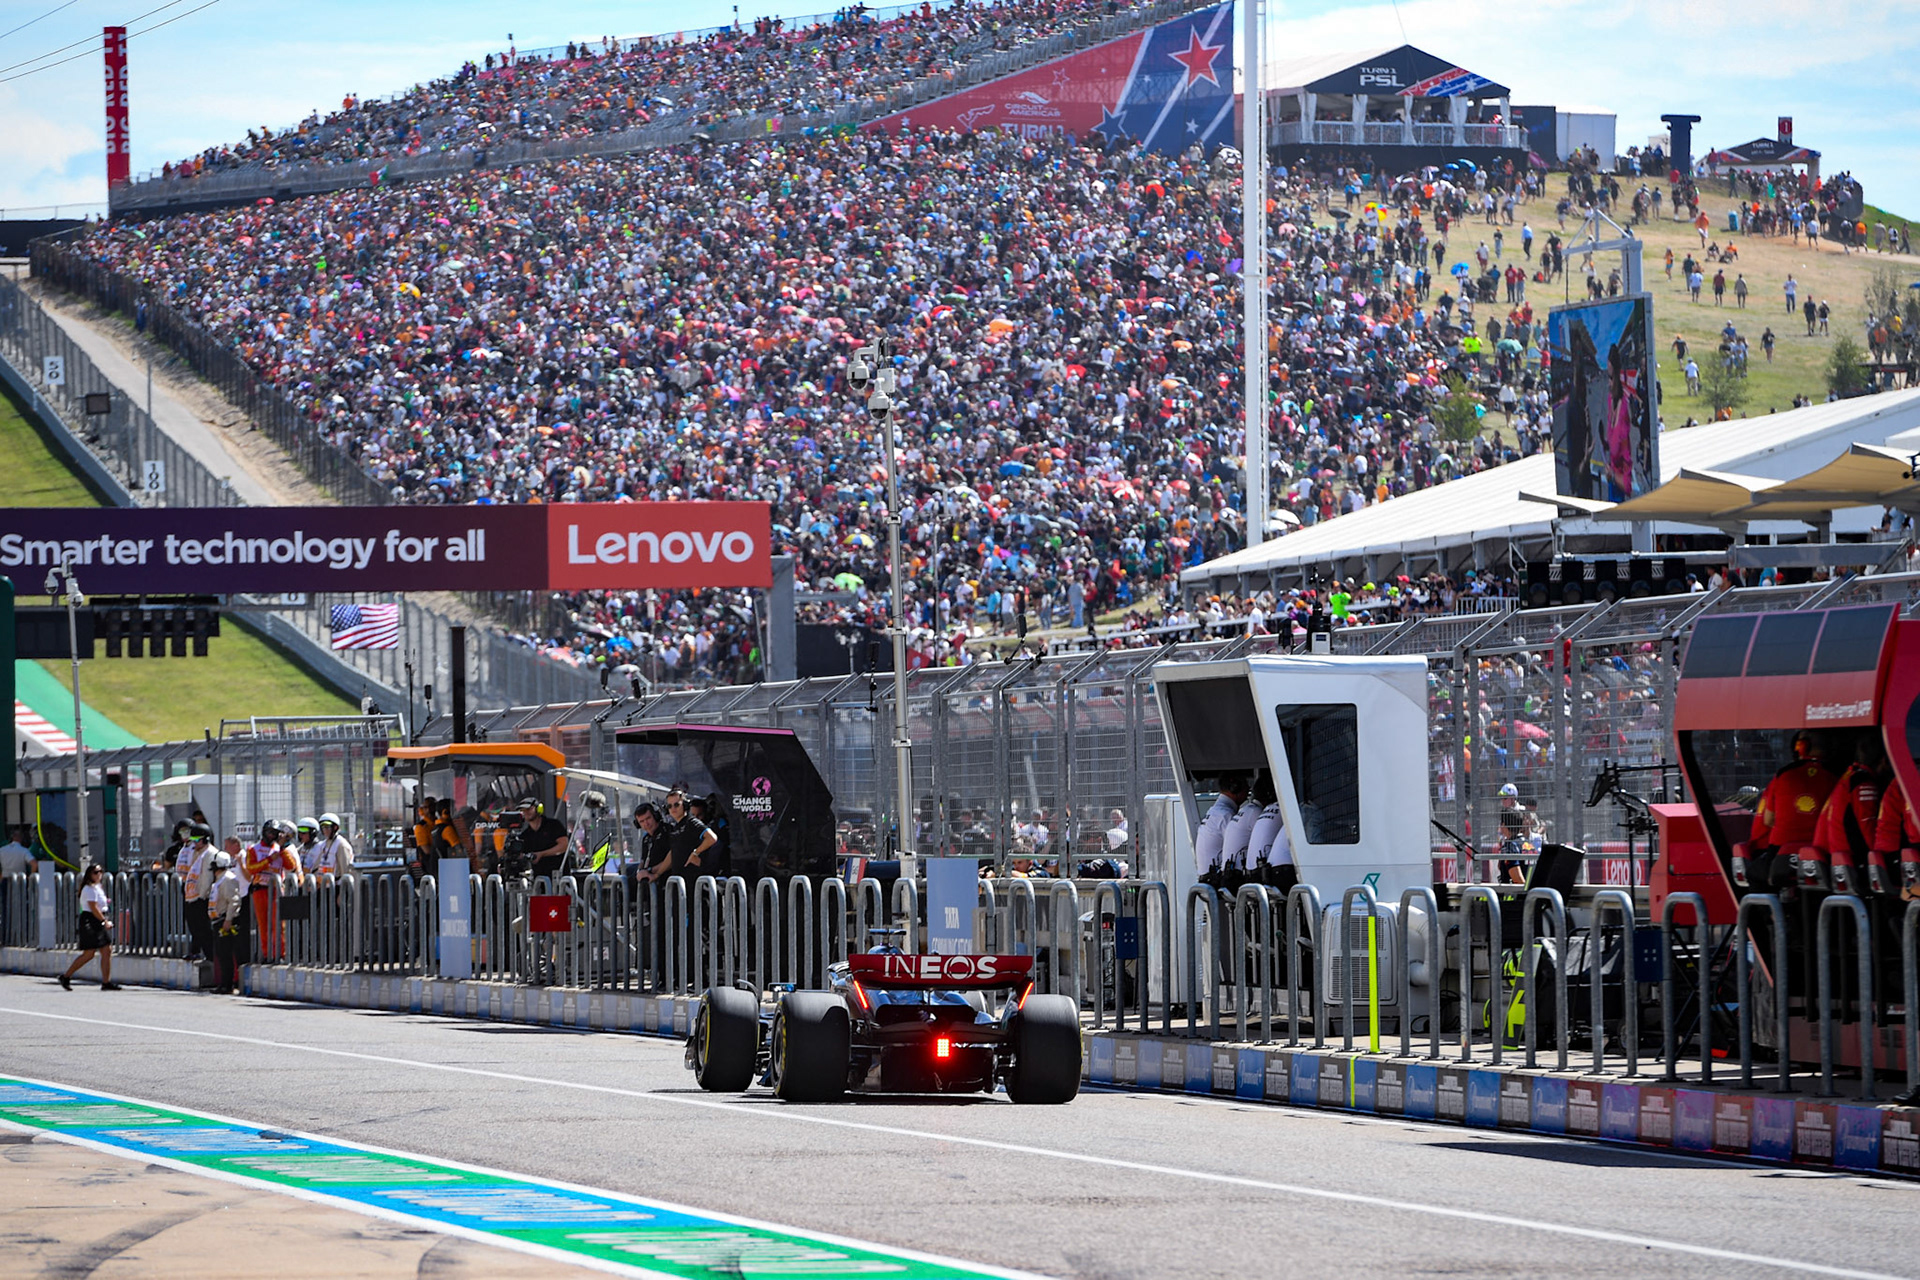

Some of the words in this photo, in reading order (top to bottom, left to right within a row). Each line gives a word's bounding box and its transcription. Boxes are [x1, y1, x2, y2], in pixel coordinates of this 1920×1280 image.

[1360, 75, 1404, 86] PSL
[148, 462, 160, 490] 100
[0, 534, 153, 566] Smarter
[164, 530, 375, 570] technology
[384, 529, 438, 563] for
[445, 528, 485, 562] all
[567, 523, 754, 565] Lenovo
[732, 797, 772, 805] CHANGE
[1605, 858, 1642, 885] Lenoo
[944, 906, 960, 929] TATA
[883, 955, 998, 980] INEOS
